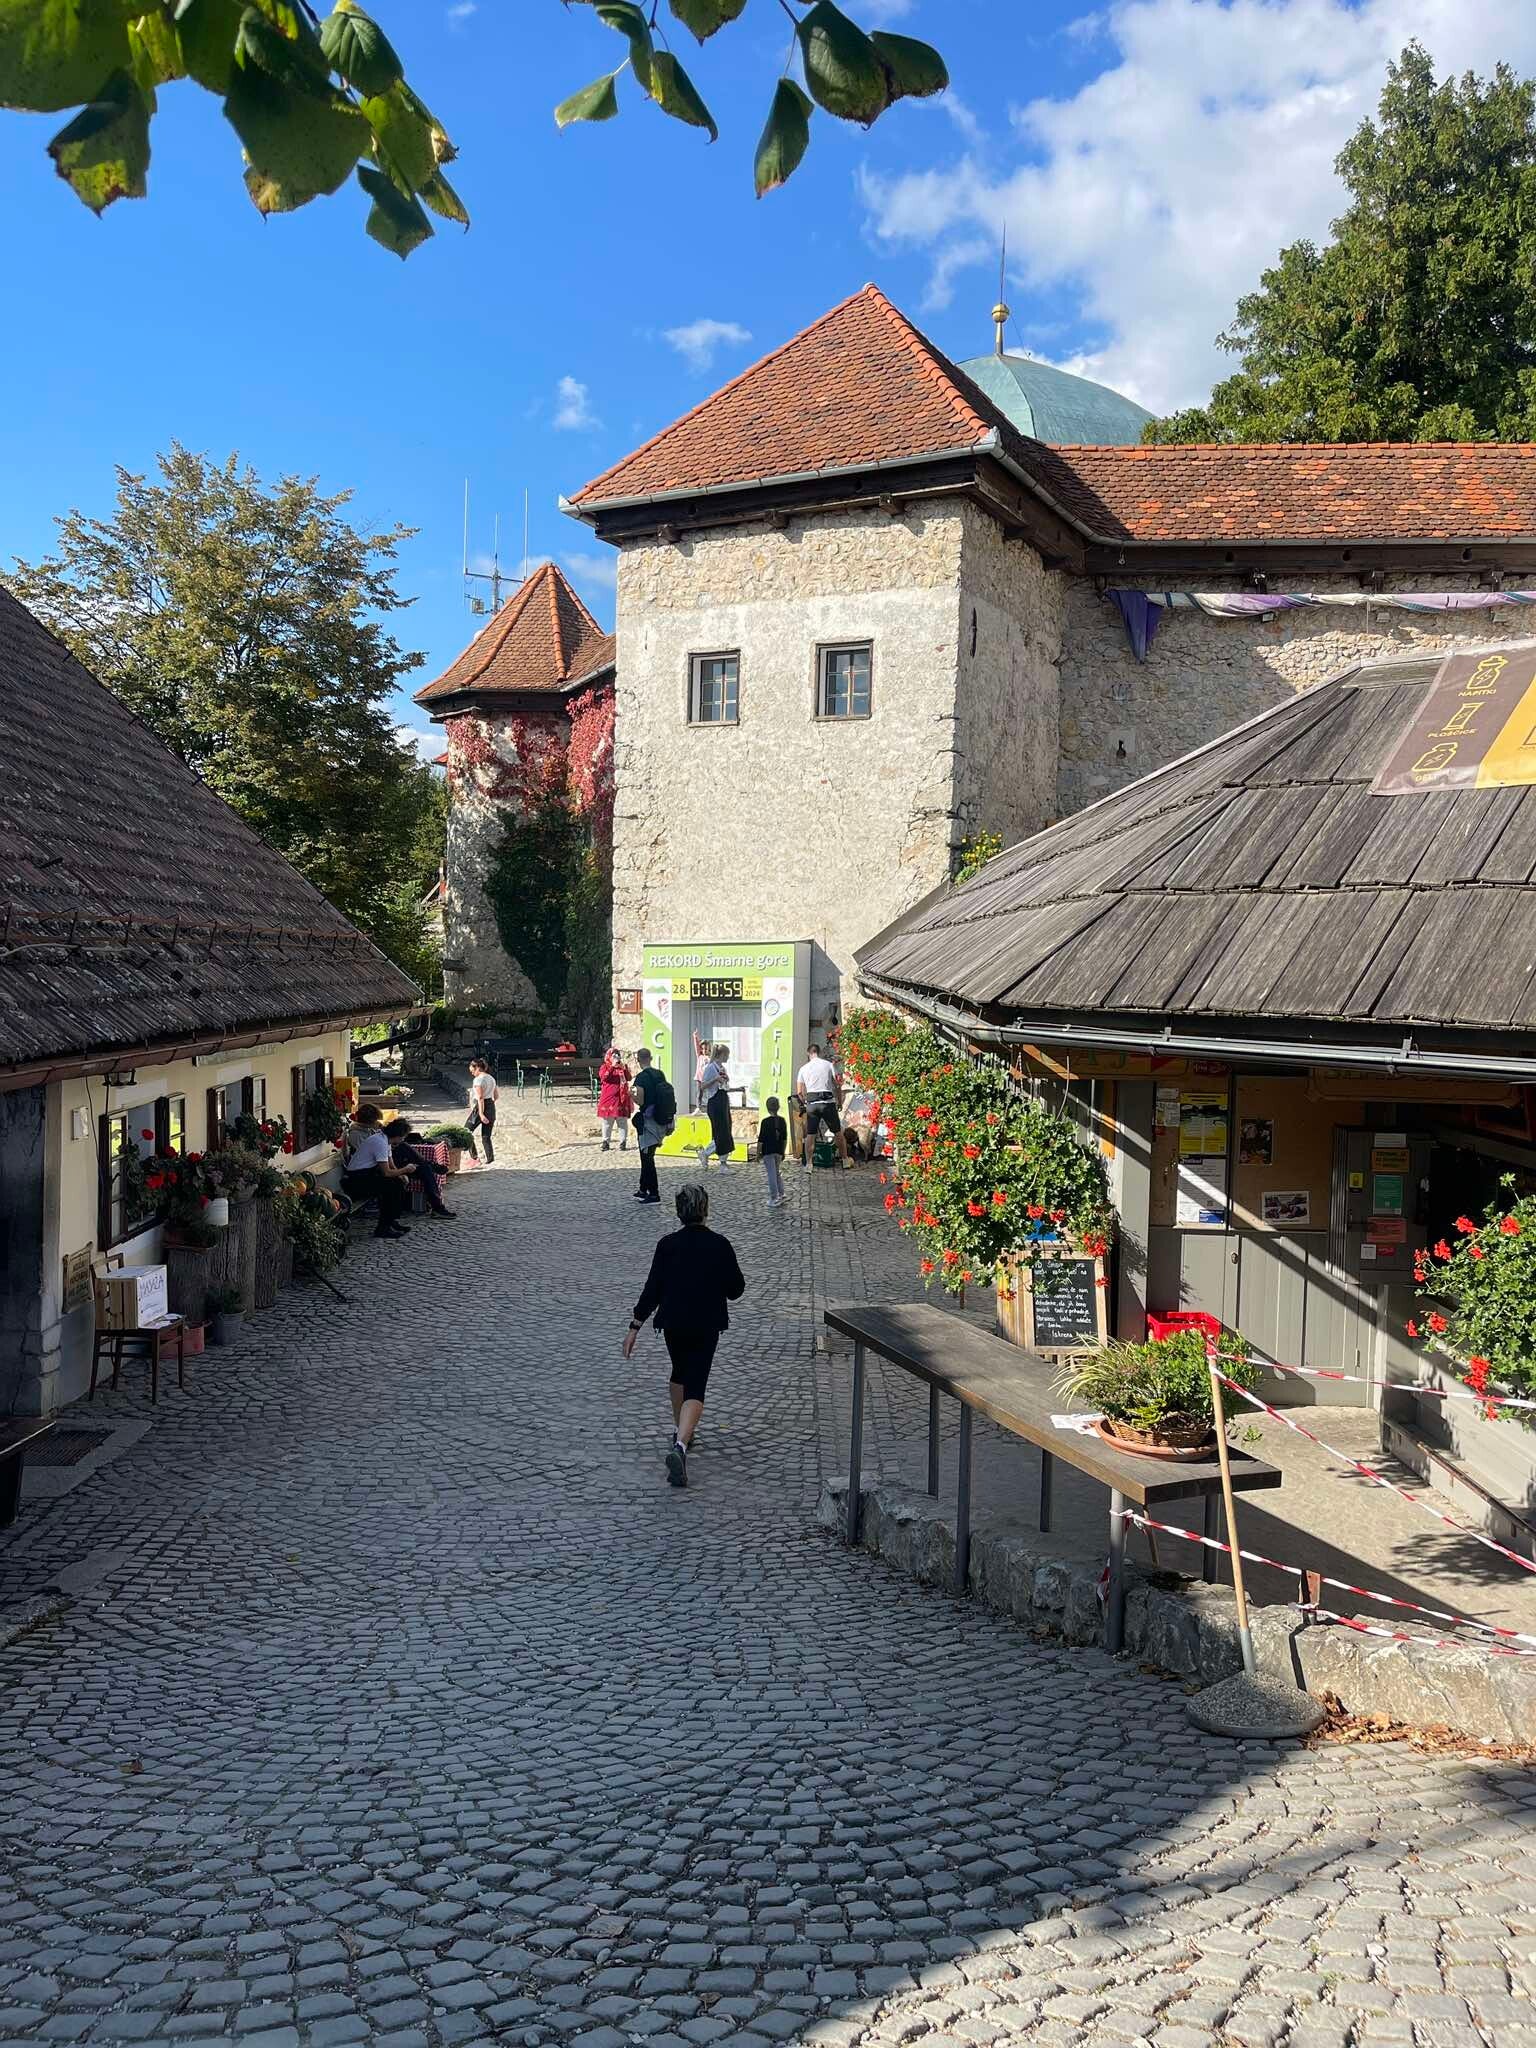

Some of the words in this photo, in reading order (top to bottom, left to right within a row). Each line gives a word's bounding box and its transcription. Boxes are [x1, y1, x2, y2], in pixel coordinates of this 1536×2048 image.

[1457, 688, 1497, 697] NAPITKI
[649, 954, 702, 968] REKORD
[705, 952, 754, 968] Šmarne
[757, 954, 789, 970] gore
[672, 984, 689, 994] 28.
[620, 991, 635, 1001] WC
[771, 1030, 783, 1094] FINI
[690, 1121, 696, 1133] 1
